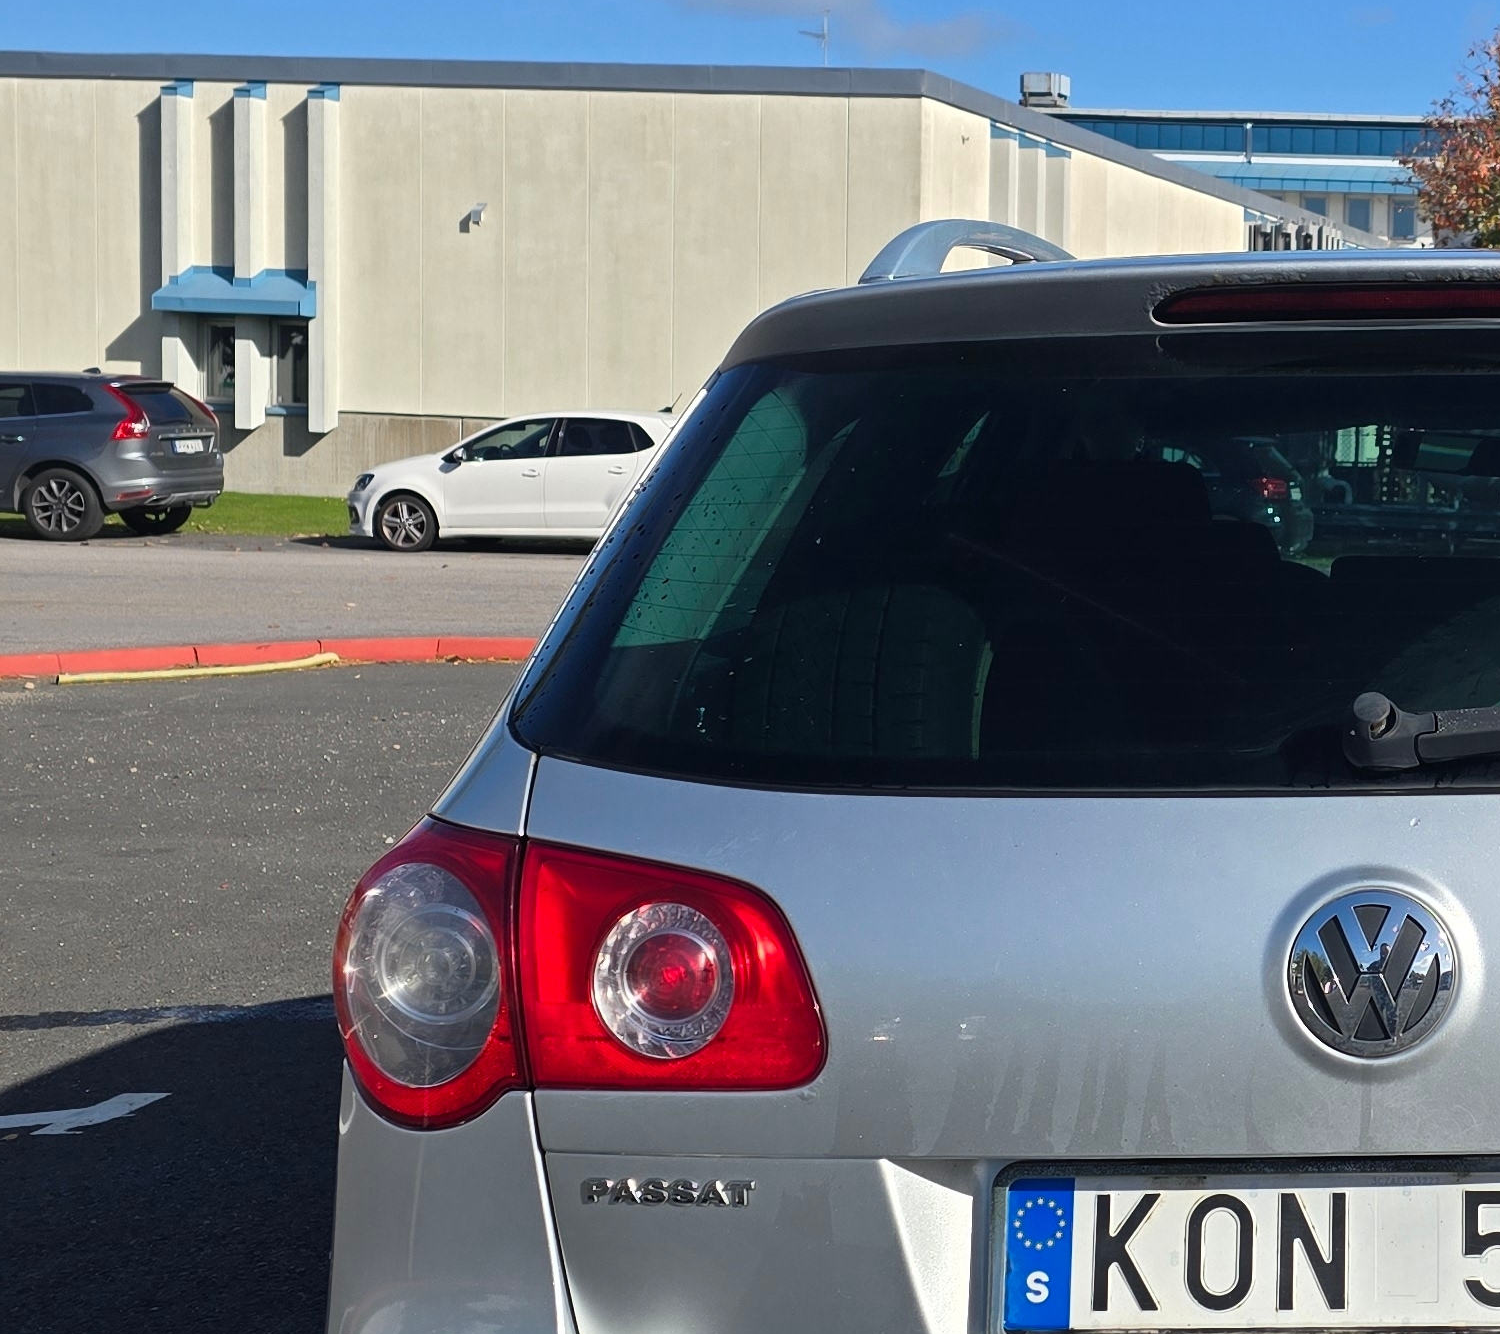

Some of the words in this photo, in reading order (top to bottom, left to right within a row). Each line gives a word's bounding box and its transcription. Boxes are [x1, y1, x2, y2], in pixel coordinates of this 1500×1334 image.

[1289, 889, 1456, 1057] VW
[580, 1177, 757, 1208] PASSAT
[1025, 1270, 1050, 1304] S
[1092, 1192, 1347, 1312] KON
